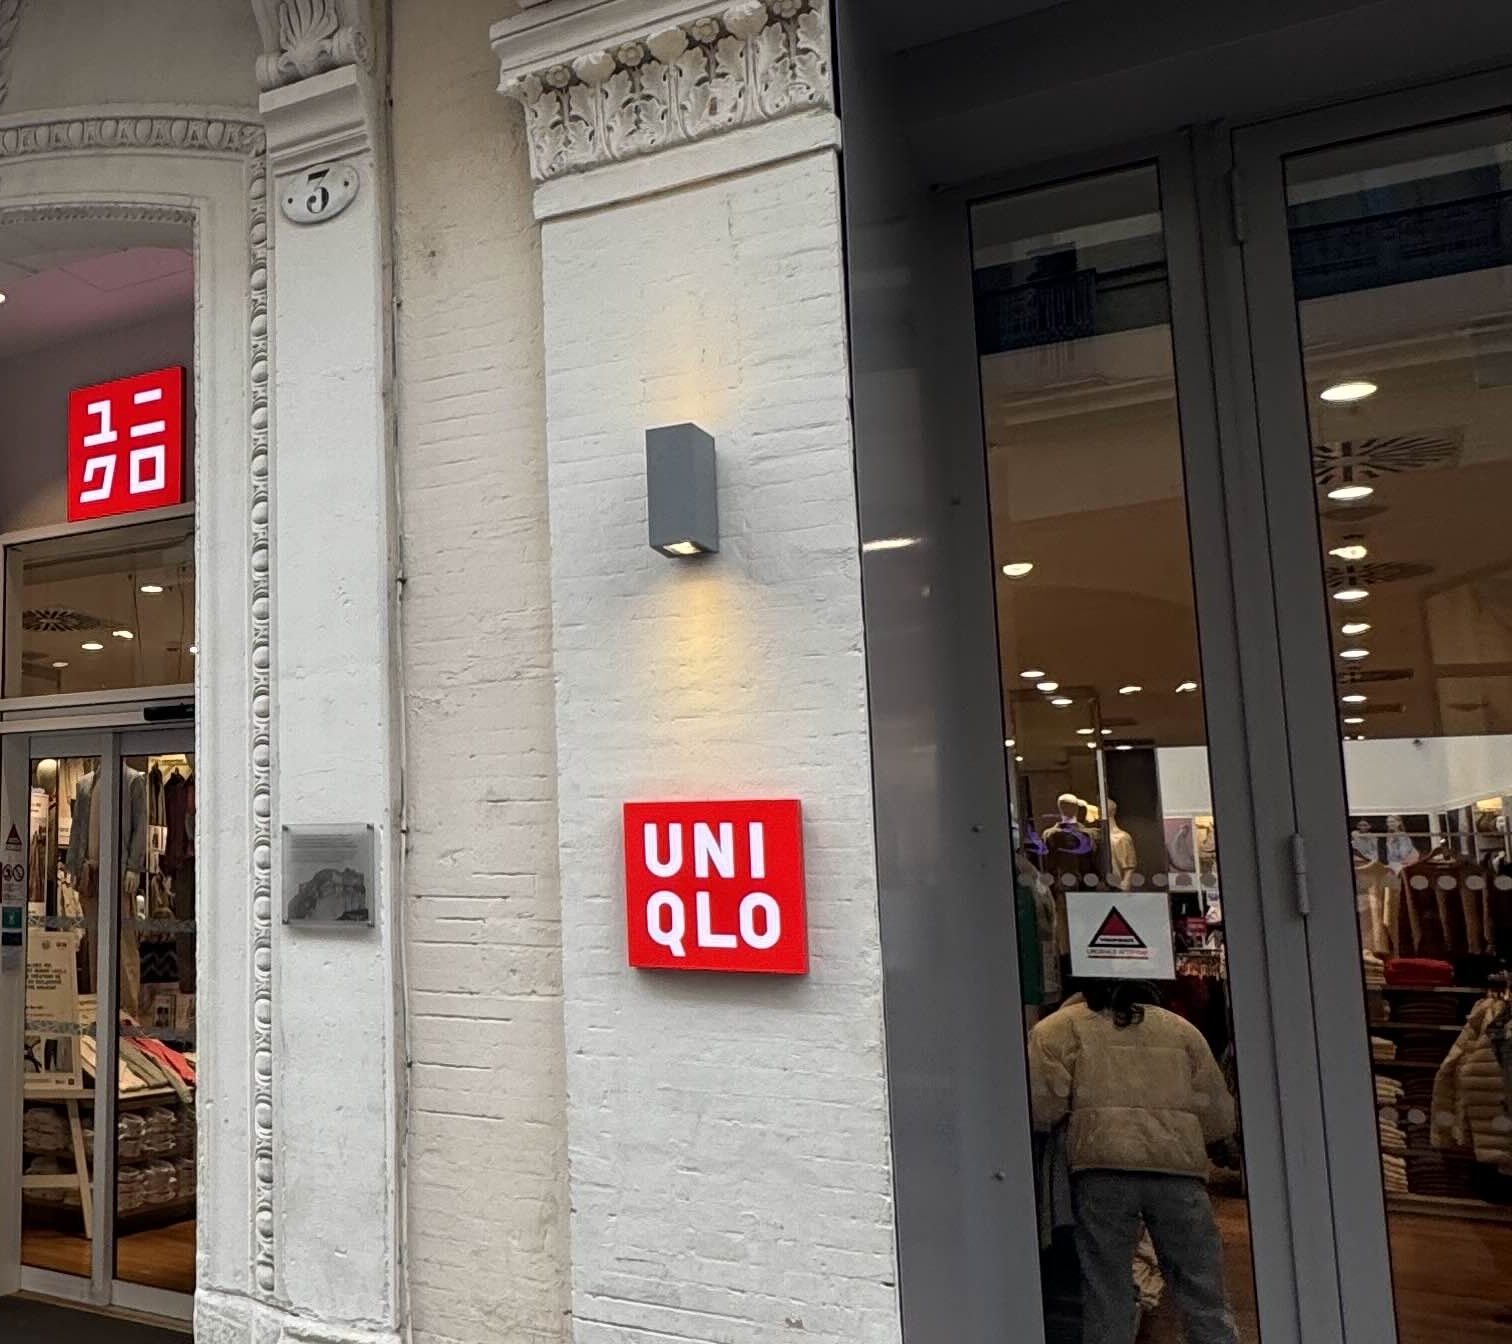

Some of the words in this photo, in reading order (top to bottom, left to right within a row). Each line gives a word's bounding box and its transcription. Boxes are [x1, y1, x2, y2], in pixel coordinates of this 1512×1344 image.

[305, 167, 331, 214] 3
[643, 821, 766, 879] UNI
[646, 890, 781, 957] QLO
